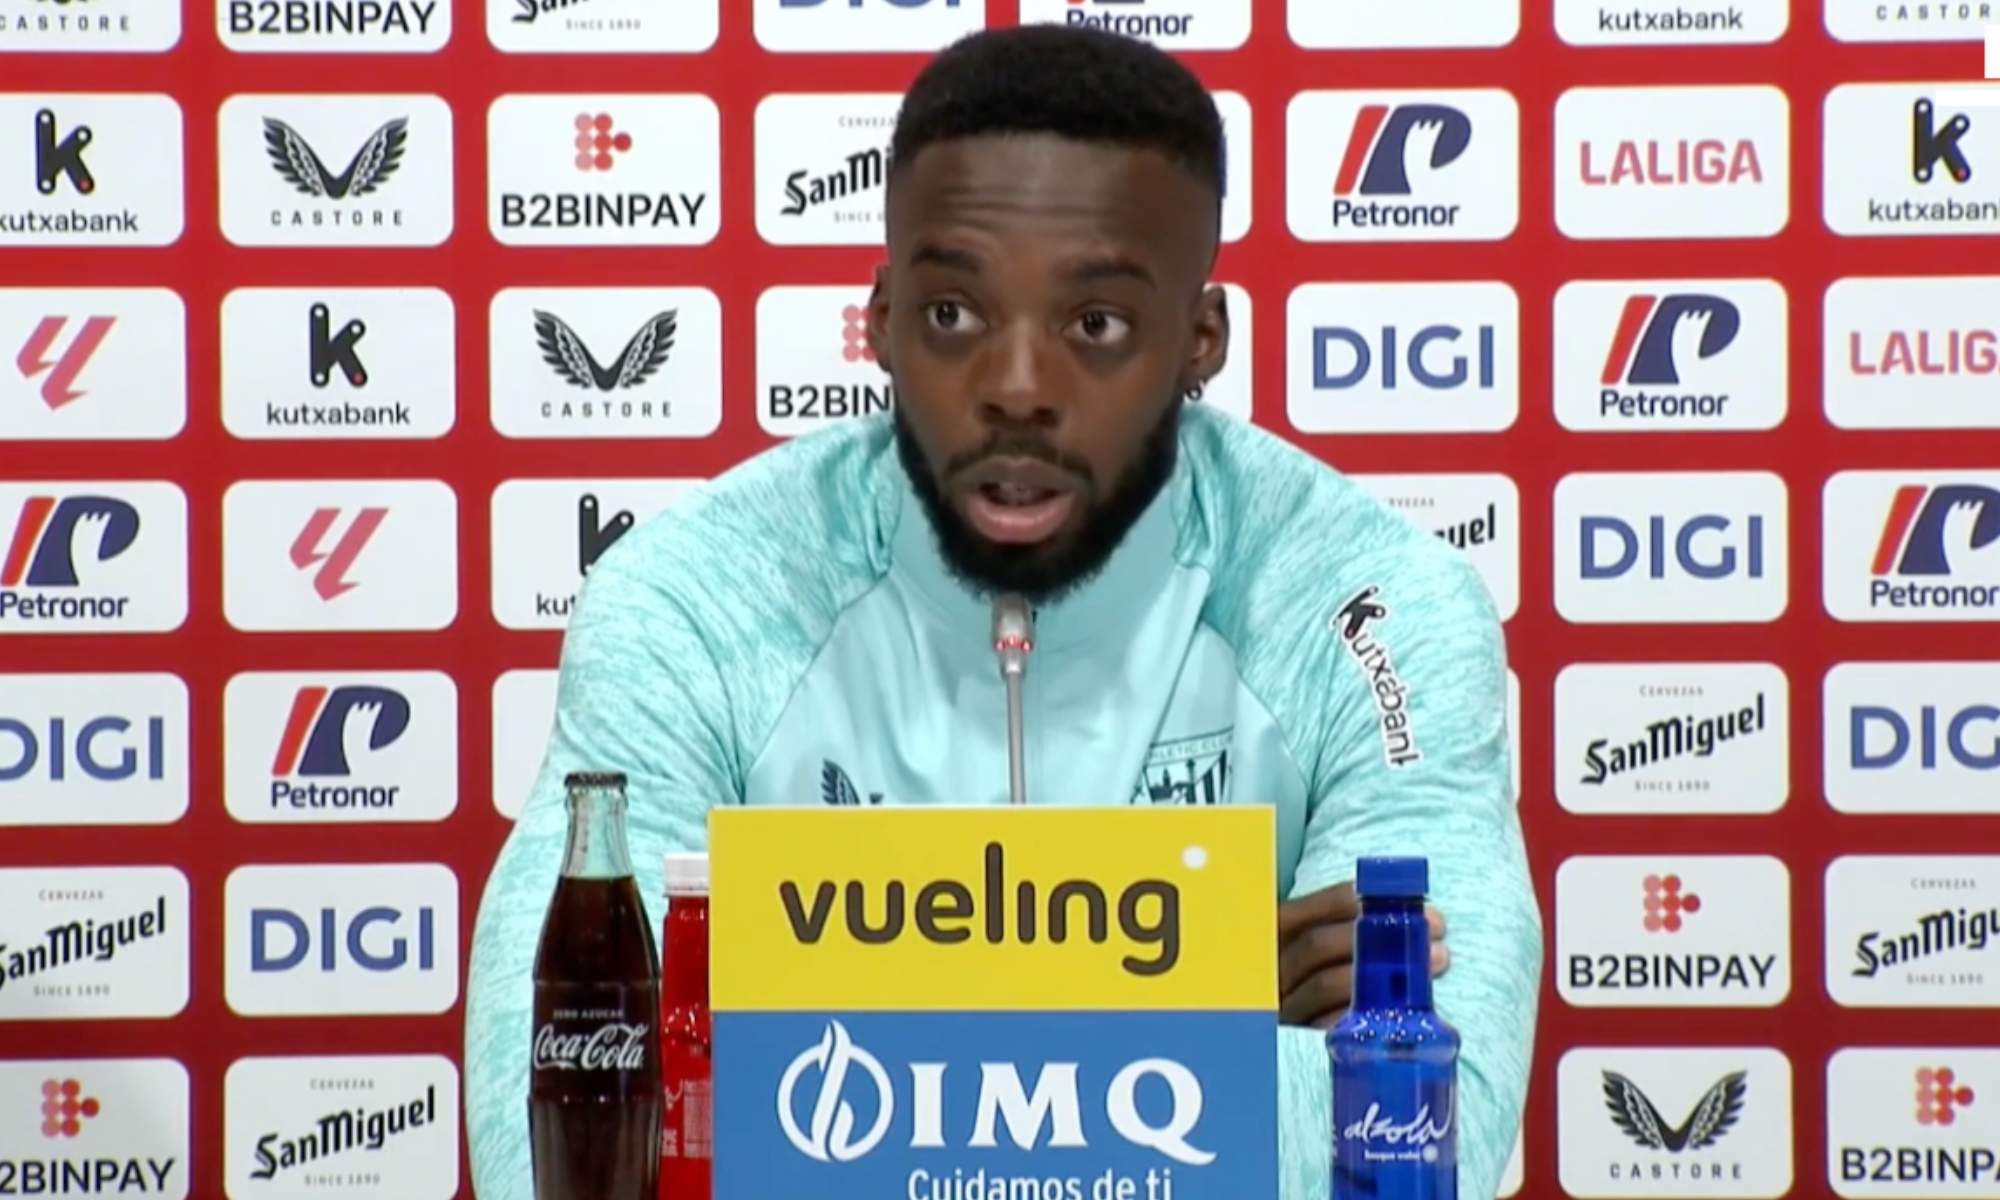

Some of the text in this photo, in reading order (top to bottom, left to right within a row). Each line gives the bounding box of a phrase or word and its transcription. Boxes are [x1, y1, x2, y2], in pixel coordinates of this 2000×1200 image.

[230, 0, 435, 33] B2BINPAY
[1066, 10, 1193, 35] Petronor
[1599, 8, 1742, 30] kutxabank
[1876, 3, 1990, 20] CASTOR
[839, 116, 895, 128] CERVEZA
[1580, 139, 1762, 185] LALIGA
[271, 210, 401, 226] CASTORE
[502, 194, 705, 227] B2BINPAY
[1333, 200, 1460, 227] Petronor
[1869, 199, 1998, 221] kutxaban
[1313, 325, 1494, 389] DIGI
[1850, 330, 2000, 375] LALIG
[267, 402, 409, 424] kutxabank
[541, 402, 670, 417] CASTORE
[769, 384, 890, 418] B2BIN
[1601, 389, 1728, 417] Petronor
[1580, 515, 1763, 579] DIGI
[0, 591, 129, 619] Petronor
[1871, 580, 2000, 607] Petronor
[0, 716, 164, 781] DIGI
[1850, 705, 2000, 770] DIG
[272, 781, 399, 808] Petronor
[779, 841, 1181, 976] vueling
[0, 896, 165, 988] anMiguel
[251, 906, 433, 972] DIGI
[1852, 908, 2000, 977] SanMigu
[1570, 955, 1775, 988] B2BINPAY
[533, 1022, 650, 1071] Coca-Cola
[909, 1057, 1217, 1166] IMQ
[0, 1158, 174, 1194] 2BINPAY
[1610, 1163, 1740, 1179] CASTORE
[1841, 1147, 2000, 1181] B2BINP
[909, 1168, 1170, 1200] Cuidamos de ti
